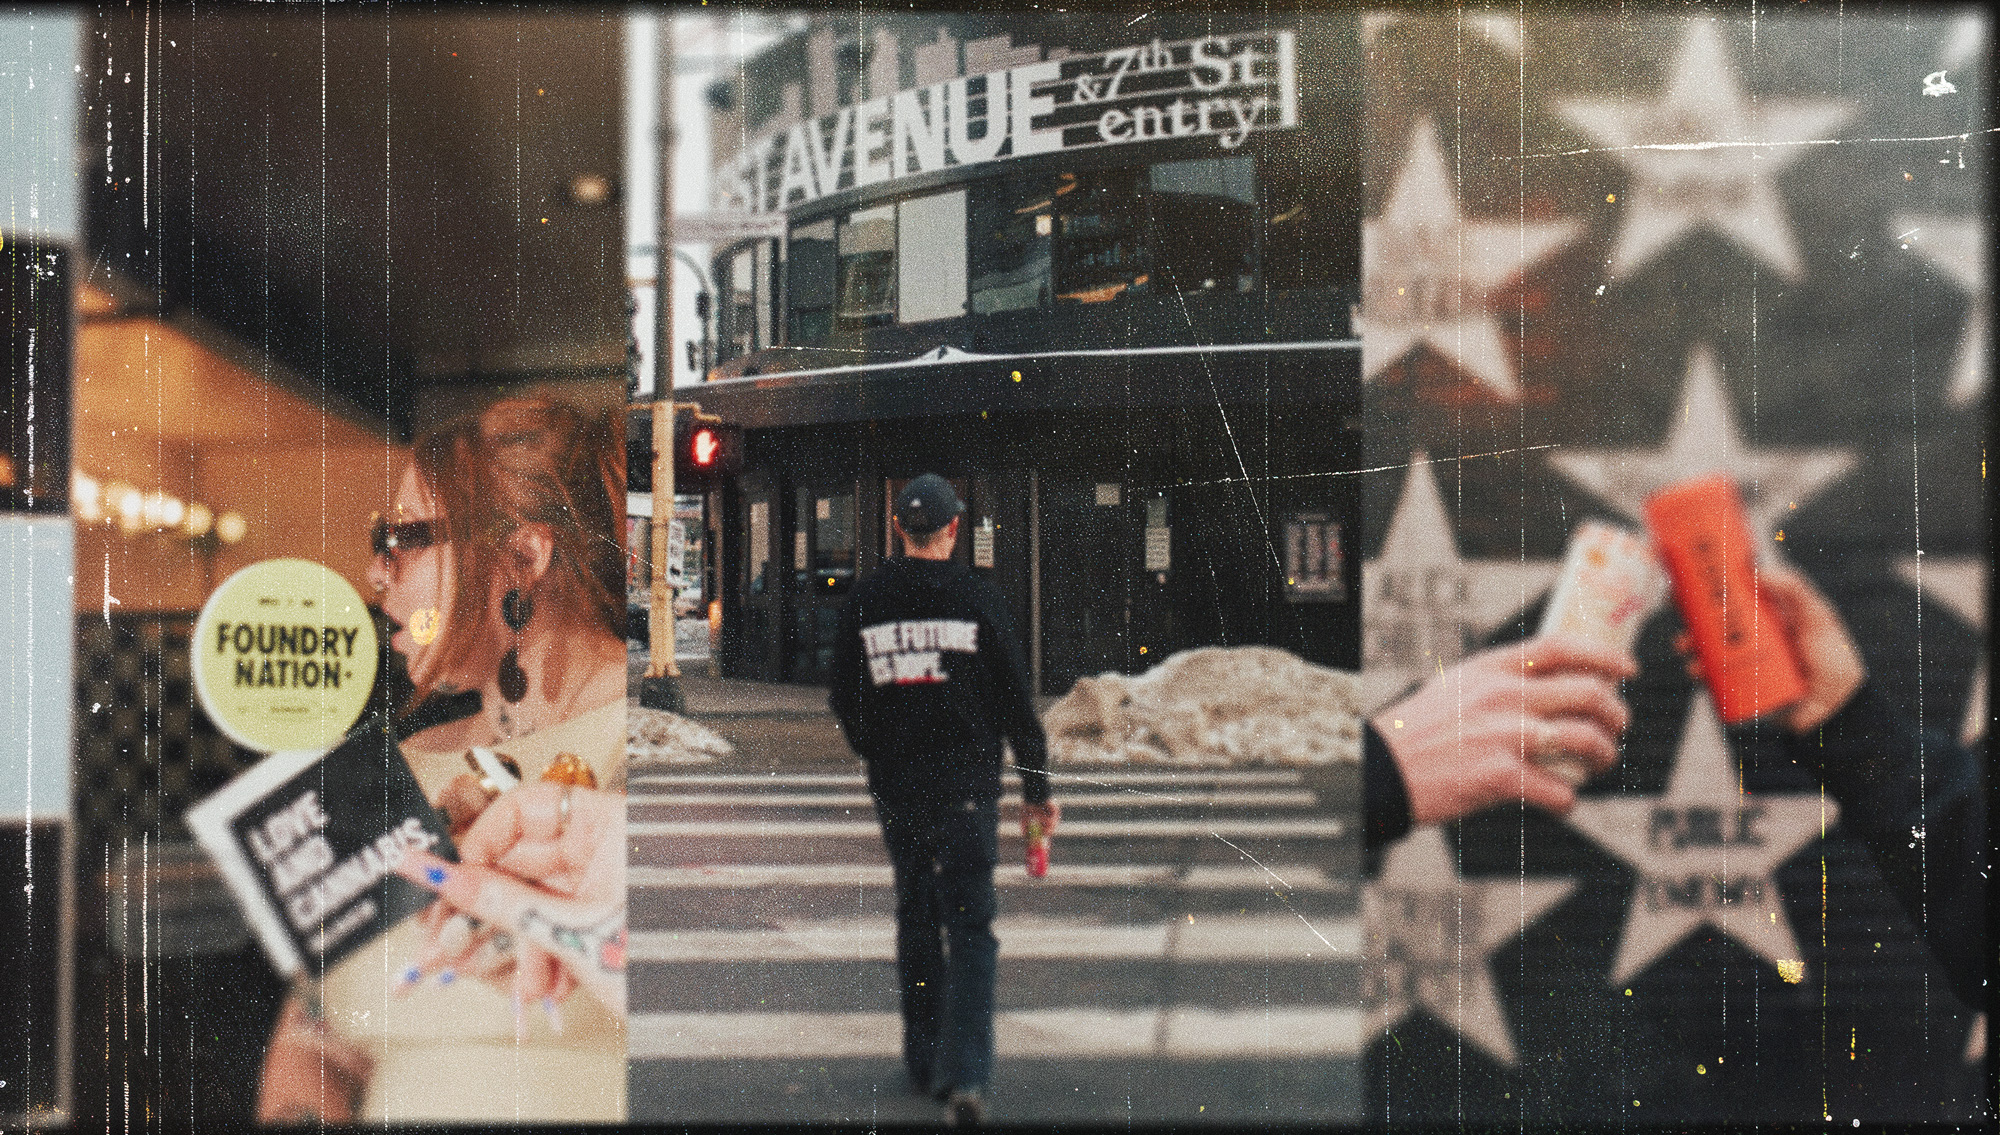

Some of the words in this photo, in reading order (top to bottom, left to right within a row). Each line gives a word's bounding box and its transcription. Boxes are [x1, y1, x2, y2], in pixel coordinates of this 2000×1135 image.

[777, 61, 1064, 209] AVENUE
[1073, 73, 1101, 102] &
[1102, 38, 1173, 100] 7th
[1190, 36, 1275, 92] St
[1099, 98, 1269, 149] entry
[216, 621, 359, 658] FOUNDRY
[859, 621, 899, 658] THE
[900, 619, 979, 654] FUTURE
[868, 656, 893, 687] IS
[246, 789, 330, 862] LOVE
[269, 833, 335, 897] AND
